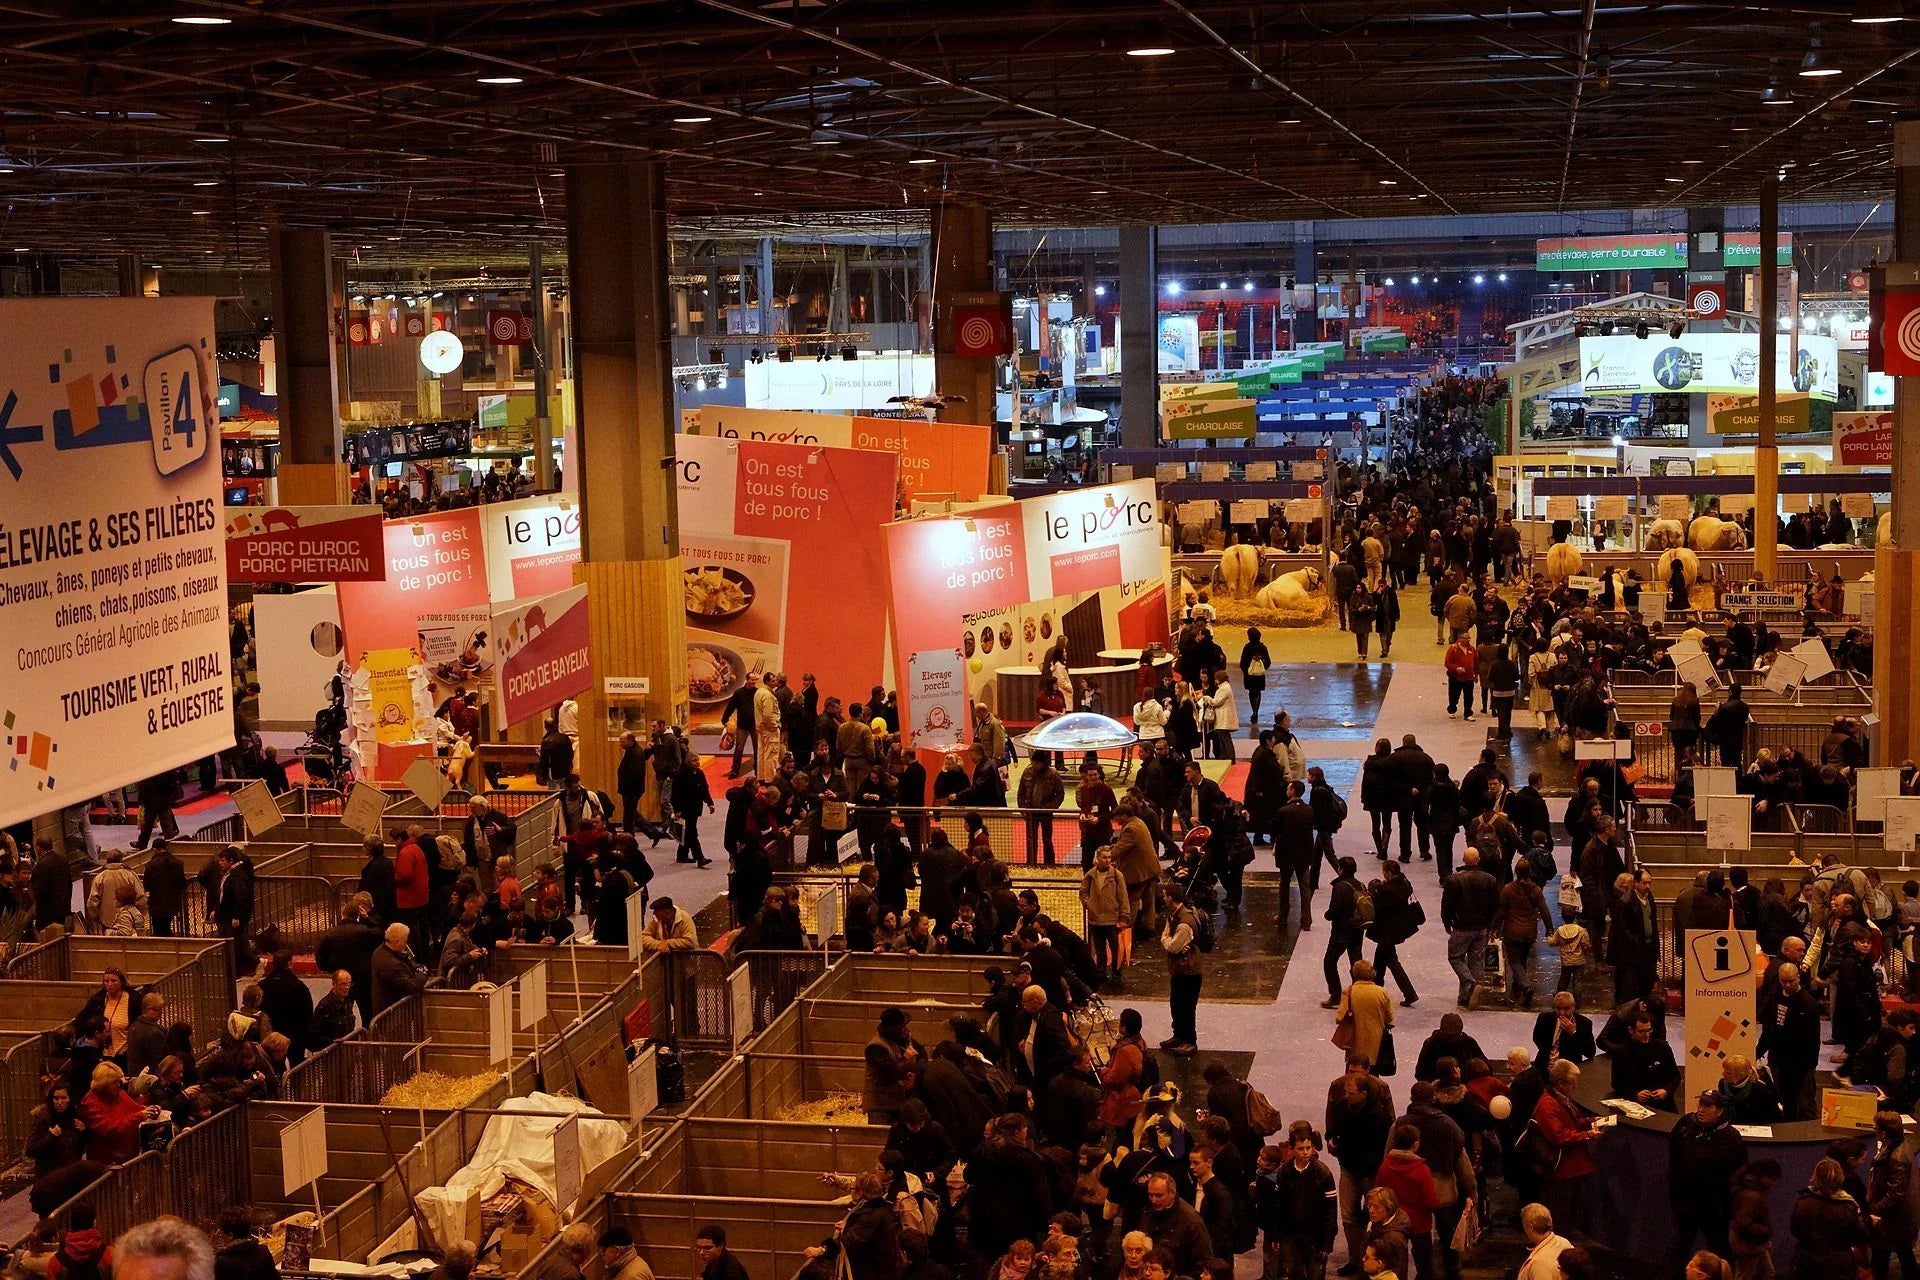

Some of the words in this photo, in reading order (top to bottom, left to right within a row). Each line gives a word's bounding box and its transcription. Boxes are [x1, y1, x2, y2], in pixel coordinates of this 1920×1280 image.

[1591, 250, 1618, 258] terre
[1852, 330, 1869, 339] LaFr
[835, 380, 851, 388] PAYS
[873, 379, 893, 387] LOIRE
[160, 372, 172, 451] Pavillon
[173, 371, 196, 448] 4
[1732, 415, 1796, 424] CHARAISE
[1186, 422, 1244, 431] CHAROLAISE
[857, 432, 878, 448] On
[884, 434, 909, 450] est
[1843, 443, 1869, 451] PORC
[746, 458, 769, 475] On
[775, 462, 804, 479] est
[746, 479, 785, 496] tous
[791, 482, 829, 501] fous
[744, 500, 766, 516] de
[772, 505, 810, 521] porc
[816, 505, 821, 521] !
[1044, 510, 1069, 542] le
[1081, 495, 1153, 544] porc
[88, 517, 103, 552] &
[106, 510, 141, 549] SES
[145, 496, 215, 542] FILIÈRES
[442, 525, 469, 543] est
[504, 515, 532, 545] le
[986, 520, 1012, 538] est
[247, 541, 295, 556] PORC
[299, 540, 360, 556] DUROC
[692, 548, 712, 559] TOUS
[713, 550, 733, 561] FOUS
[735, 552, 745, 562] DE
[978, 544, 1014, 563] fous
[1053, 547, 1118, 568] www.leporc.com
[239, 558, 287, 573] PORC
[291, 557, 370, 573] PIETRAIN
[391, 554, 430, 572] tous
[434, 546, 471, 565] fous
[56, 571, 89, 594] ânes,
[91, 563, 129, 592] poneys
[132, 557, 143, 577] et
[144, 552, 173, 580] petits
[175, 546, 217, 569] chevaux,
[400, 575, 424, 592] de
[426, 568, 462, 590] porc
[467, 565, 472, 580] !
[946, 572, 966, 590] de
[971, 565, 1005, 588] porc
[1009, 561, 1015, 577] !
[55, 600, 97, 628] chiens,
[183, 575, 219, 598] oiseaux
[1725, 594, 1752, 606] FRANCE
[1756, 595, 1795, 606] SELECTION
[427, 614, 443, 622] TOUS
[470, 614, 488, 622] PORC
[17, 642, 73, 671] Concours
[75, 626, 116, 656] Général
[119, 618, 160, 649] Agricole
[162, 612, 179, 633] des
[181, 604, 221, 629] Animaux
[508, 675, 537, 700] PORC
[536, 665, 551, 688] DE
[552, 647, 590, 680] BAYEUX
[921, 669, 952, 682] Elevage
[60, 675, 137, 722] TOURISME
[140, 664, 179, 699] VERT,
[181, 651, 223, 686] RURAL
[923, 680, 950, 692] porcin
[147, 708, 158, 735] &
[161, 686, 225, 731] ÉQUESTRE
[1695, 988, 1748, 998] Information
